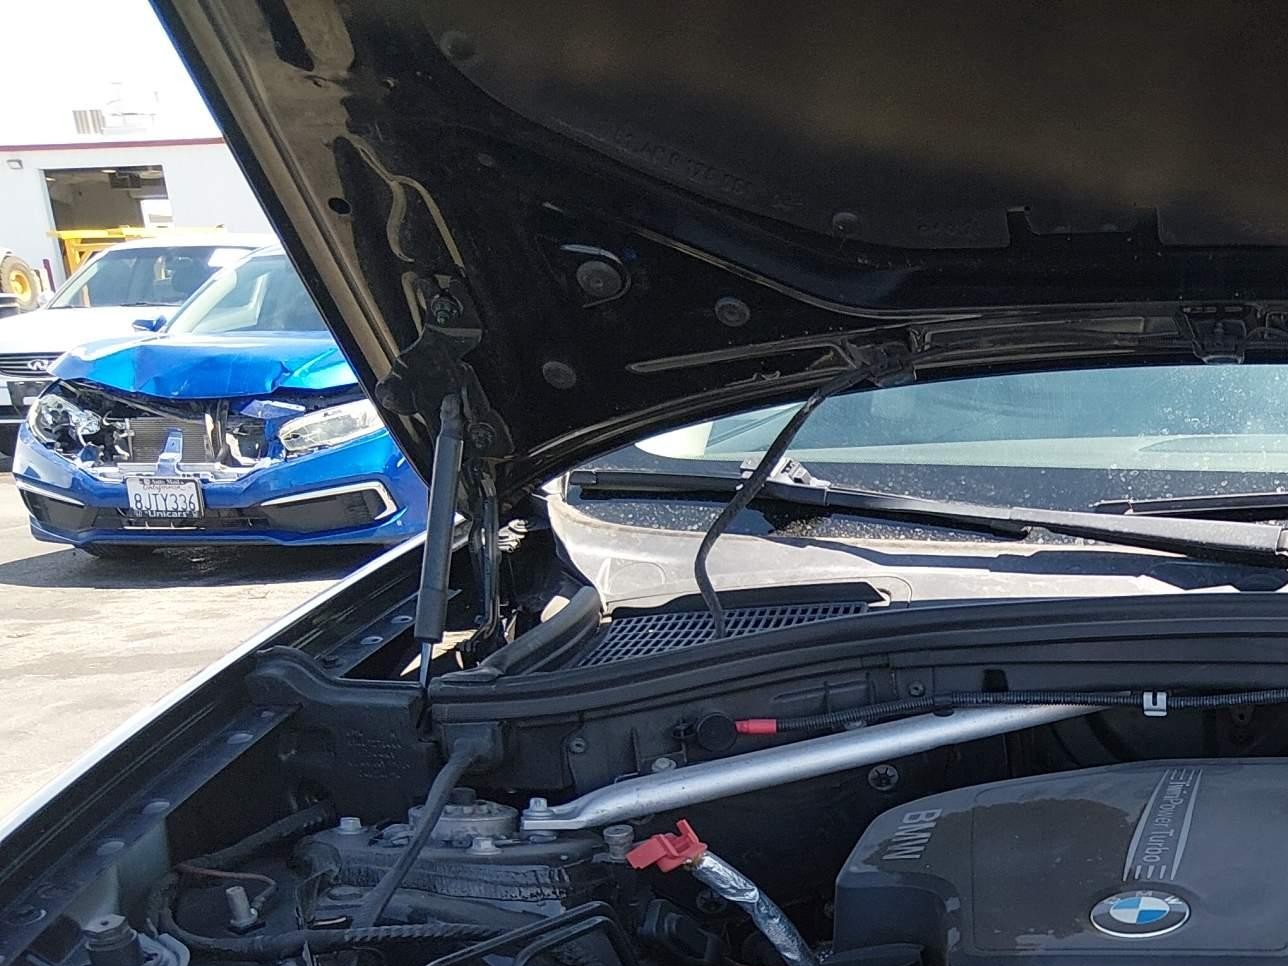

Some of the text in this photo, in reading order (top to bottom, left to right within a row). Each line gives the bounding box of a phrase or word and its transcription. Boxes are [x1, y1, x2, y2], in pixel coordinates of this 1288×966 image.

[134, 493, 196, 511] 8JTY336
[881, 808, 942, 860] BMW
[1142, 779, 1191, 863] TwinPower Turbo
